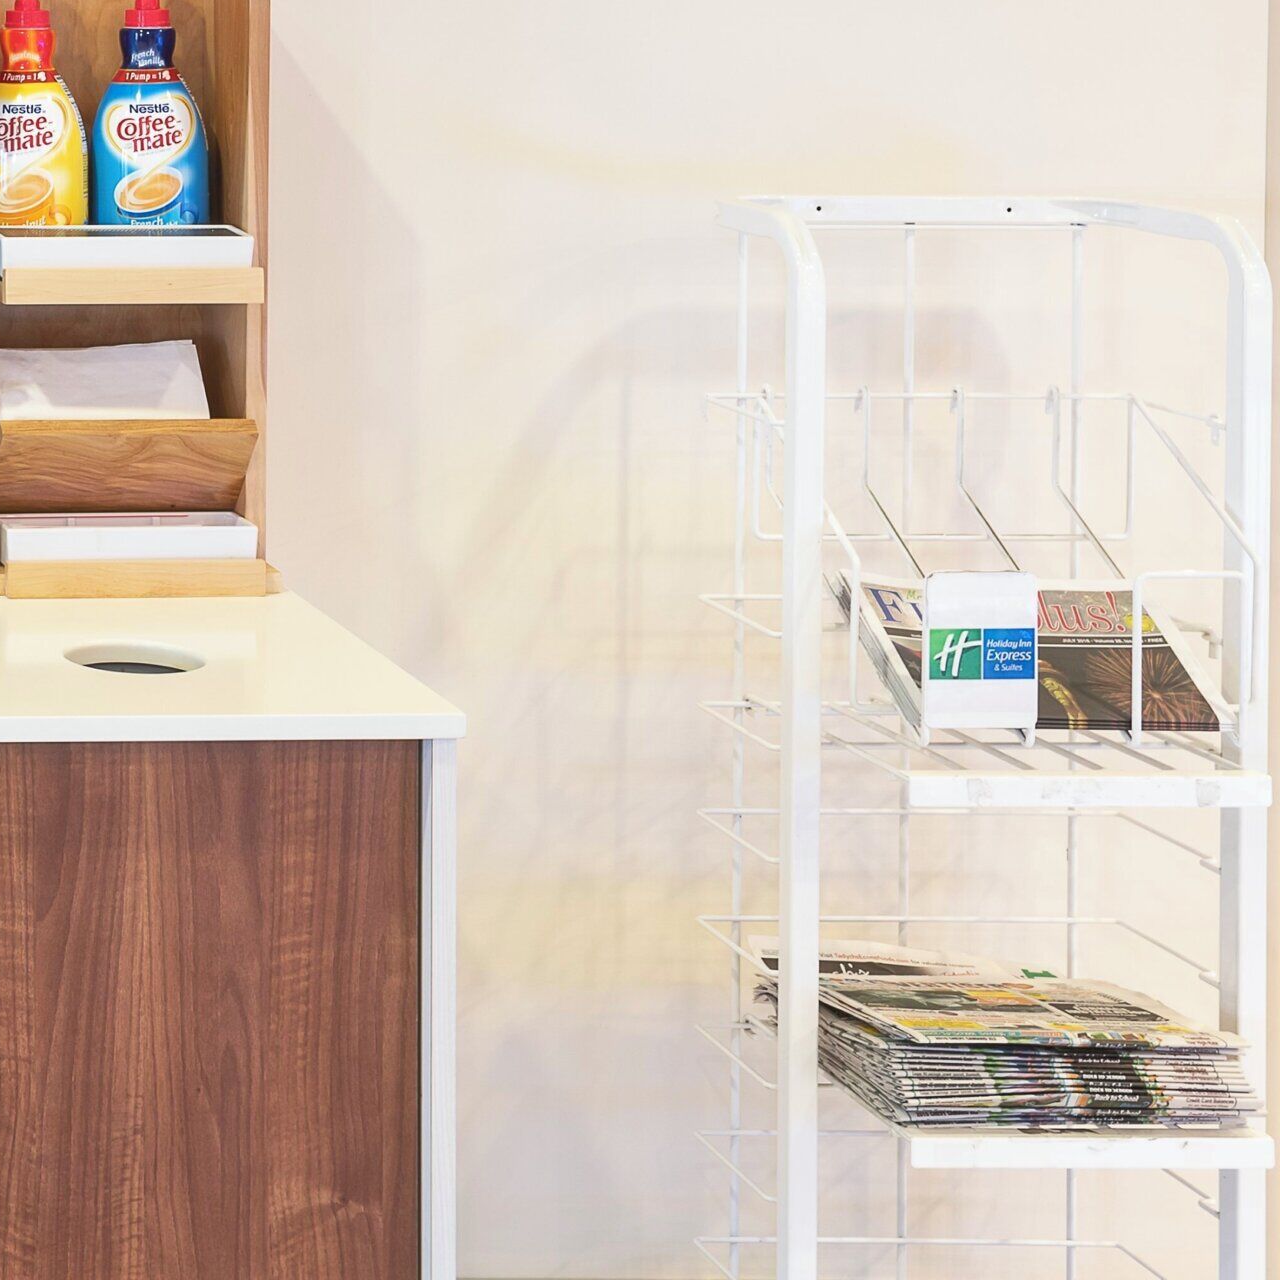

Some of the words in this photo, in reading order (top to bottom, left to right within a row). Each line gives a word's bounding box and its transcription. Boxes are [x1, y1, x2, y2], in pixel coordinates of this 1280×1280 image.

[130, 48, 155, 63] French
[137, 57, 166, 68] Vanilla
[6, 73, 26, 82] Pump
[130, 72, 151, 82] Pump
[3, 130, 53, 153] mate
[132, 129, 182, 153] mate
[986, 638, 1017, 649] Holiday
[1019, 639, 1032, 648] Inn
[986, 649, 1033, 662] Express
[993, 663, 1000, 671] &
[1001, 663, 1023, 671] Suites
[1118, 1094, 1140, 1102] School
